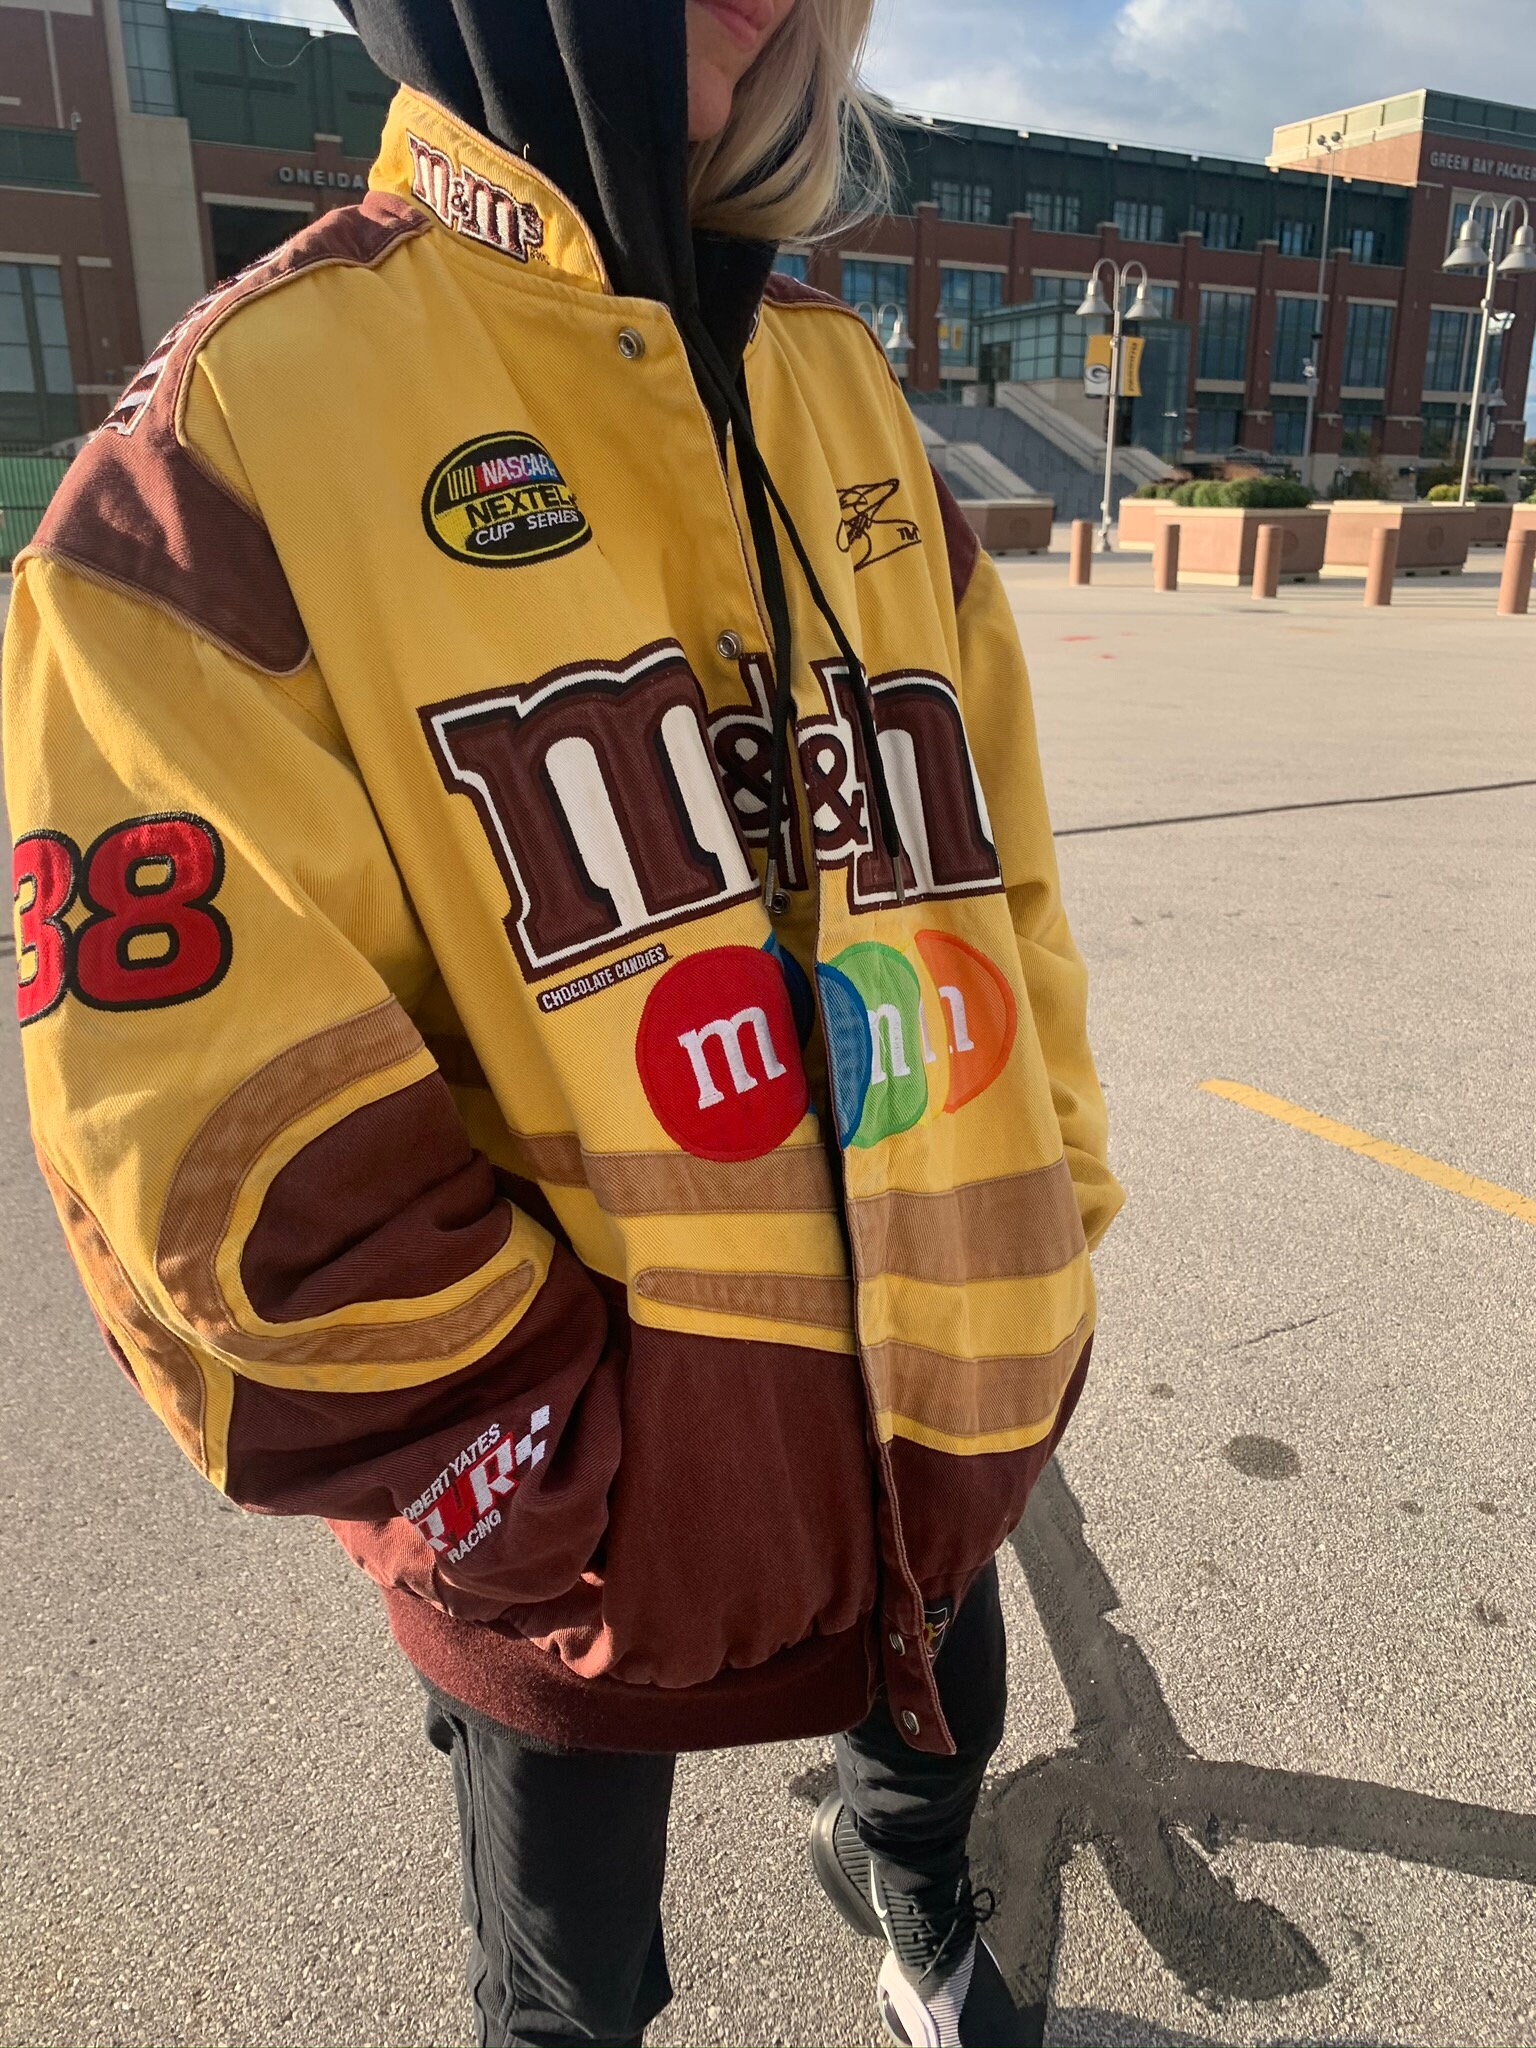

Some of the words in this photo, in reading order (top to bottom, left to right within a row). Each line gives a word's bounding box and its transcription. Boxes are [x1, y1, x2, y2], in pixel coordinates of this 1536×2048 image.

[279, 166, 365, 189] ONEIDA
[1430, 151, 1470, 171] GREEN
[1472, 157, 1495, 175] BAY
[481, 453, 551, 487] NASCAR
[465, 485, 570, 529] NEXTEL
[475, 522, 515, 546] CUP
[526, 509, 579, 530] SERIES
[14, 811, 233, 1028] 38
[541, 968, 615, 1010] CHOCOLATE
[615, 946, 665, 979] CANDIES
[678, 1006, 787, 1110] m
[402, 1467, 450, 1521] OBERT
[449, 1424, 500, 1477] YATES
[447, 1509, 502, 1564] RACING
